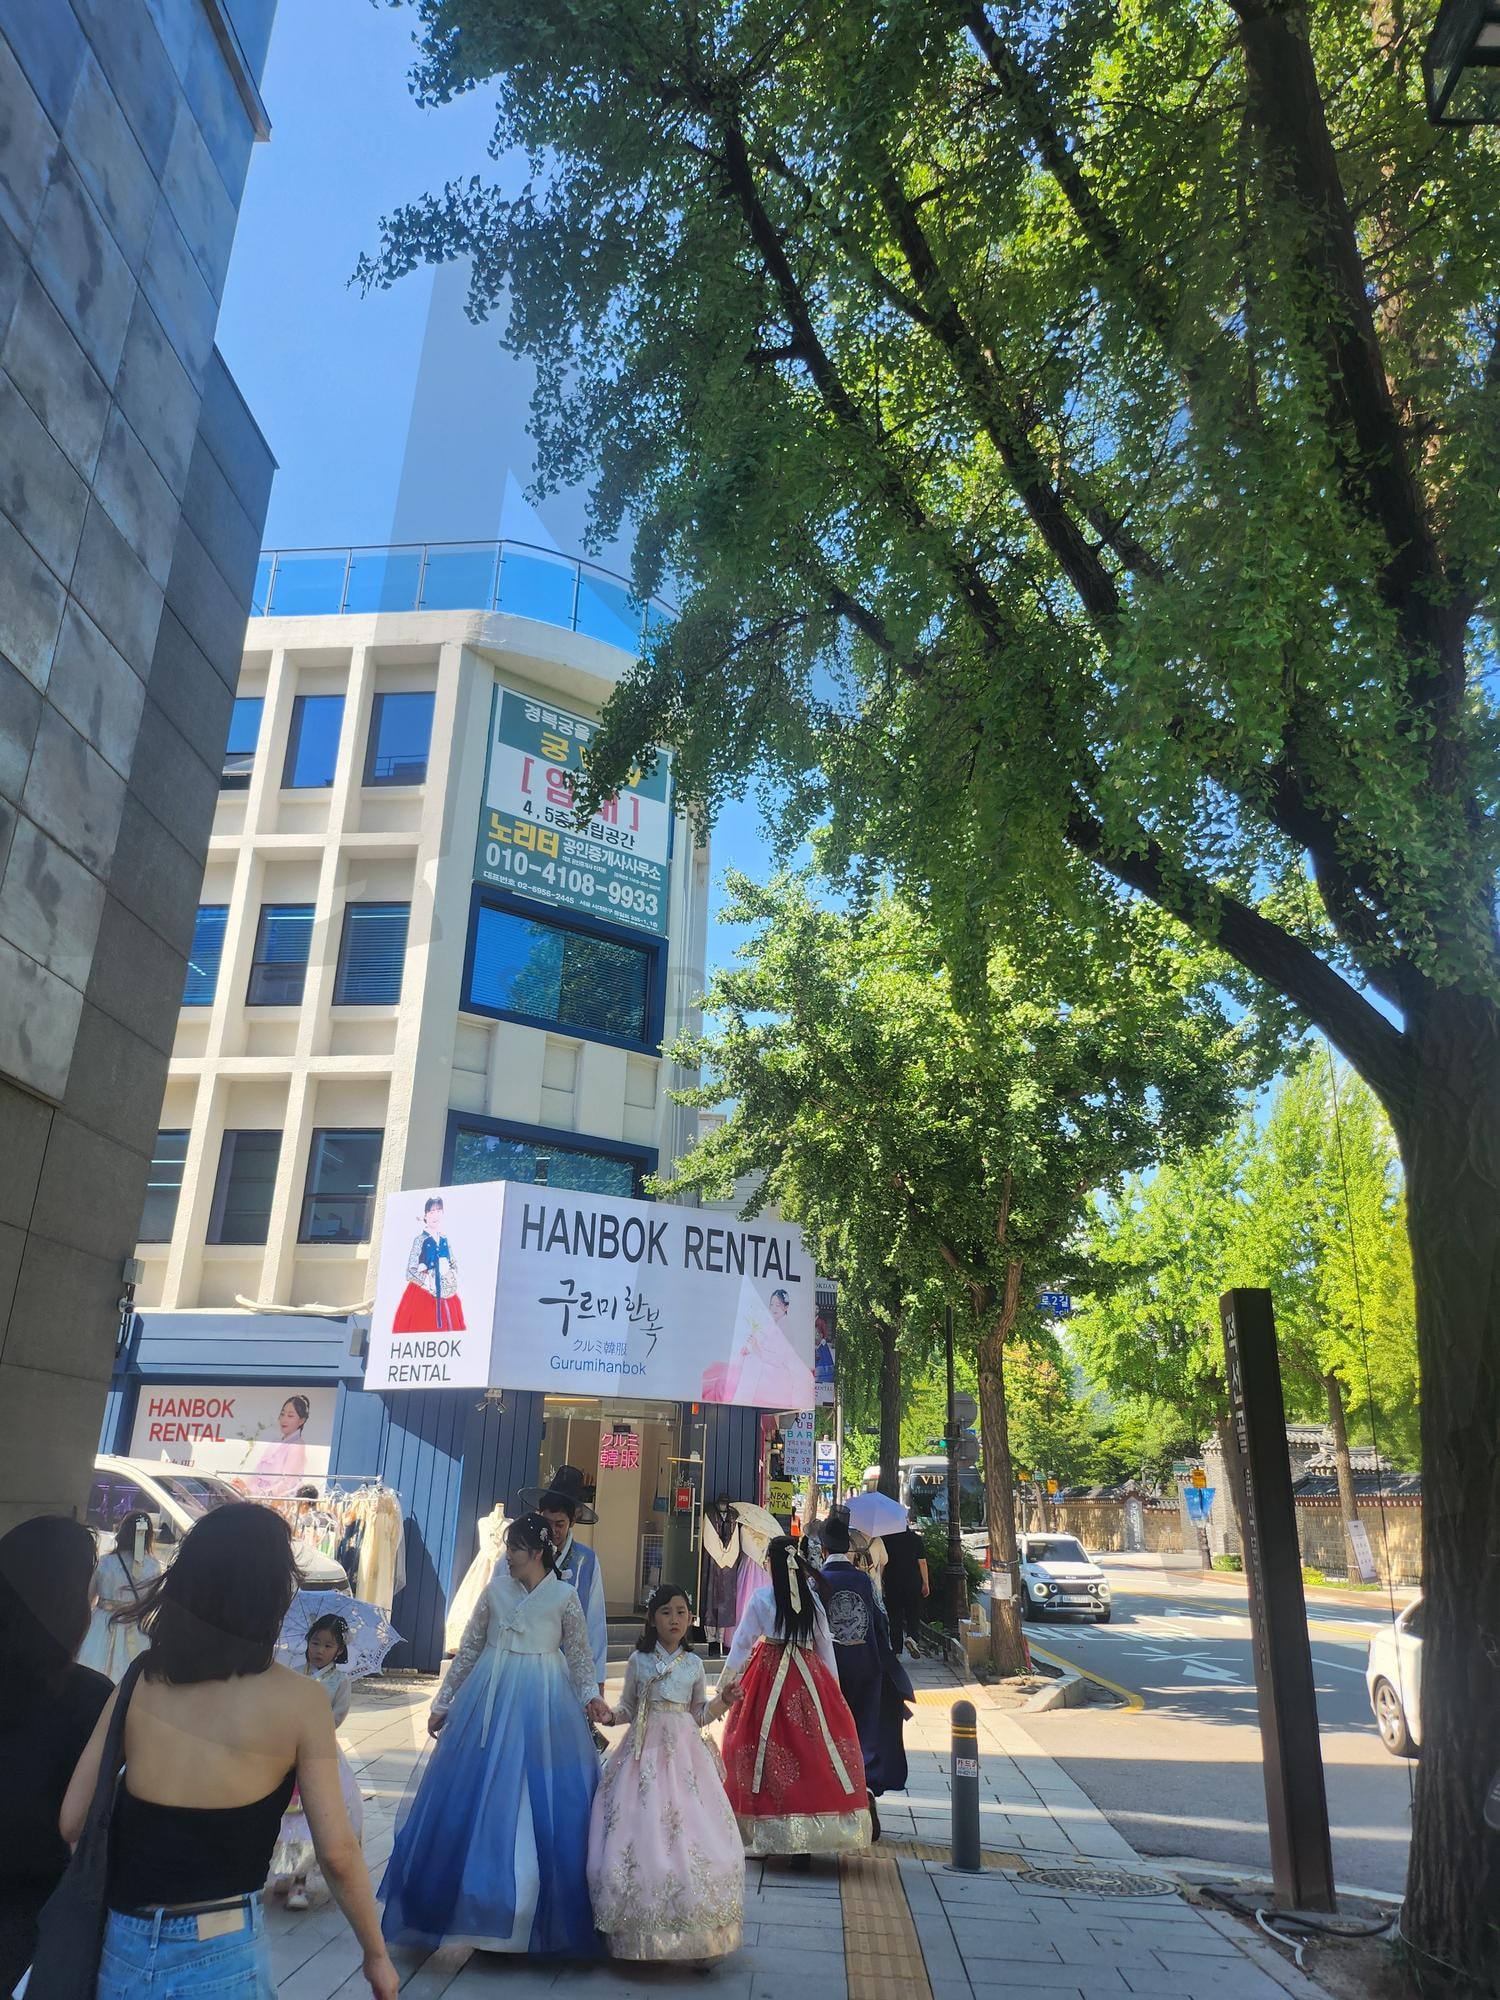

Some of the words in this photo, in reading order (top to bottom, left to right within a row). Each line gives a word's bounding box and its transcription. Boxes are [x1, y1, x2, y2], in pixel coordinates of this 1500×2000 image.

[524, 703, 590, 741] 경복궁을
[488, 812, 560, 859] 노리터
[562, 837, 661, 881] 공인중개사사무소
[486, 842, 658, 917] 010-4108-9933
[520, 1203, 669, 1266] HANBOK
[684, 1225, 801, 1282] RENTAL
[390, 1339, 462, 1359] HANBOK
[573, 1338, 628, 1356] クルミ韓服
[388, 1363, 451, 1382] RENTAL
[550, 1355, 647, 1376] Gurumihanbok
[148, 1398, 236, 1418] HANBOK
[149, 1422, 225, 1443] RENTAL
[601, 1433, 639, 1447] クルミ
[786, 1430, 813, 1438] BAR
[600, 1449, 639, 1469] 韓服
[920, 1475, 945, 1485] VIP
